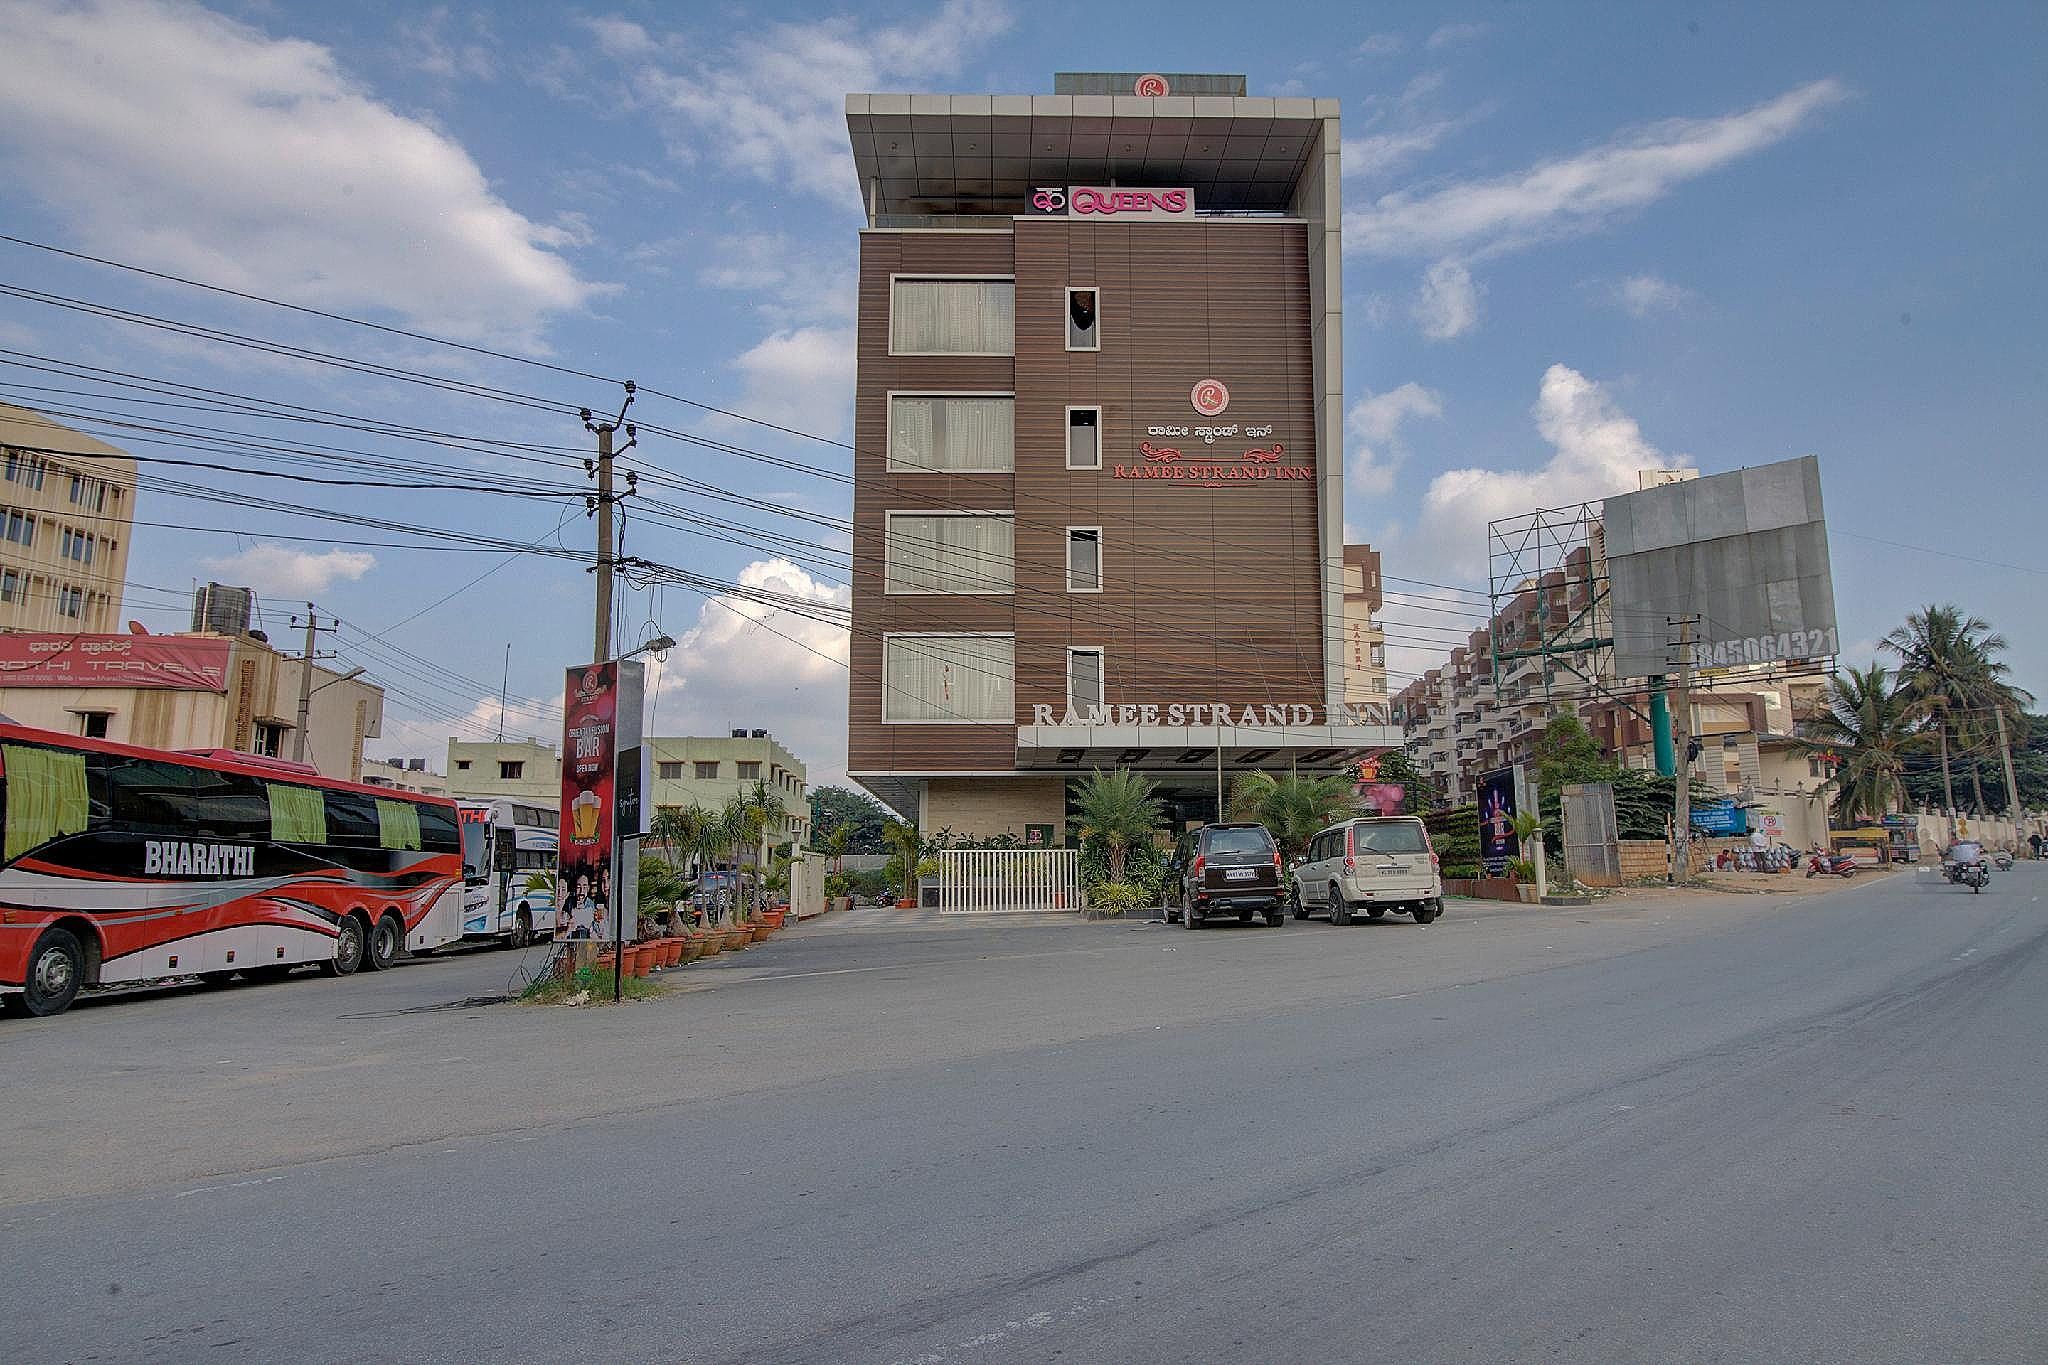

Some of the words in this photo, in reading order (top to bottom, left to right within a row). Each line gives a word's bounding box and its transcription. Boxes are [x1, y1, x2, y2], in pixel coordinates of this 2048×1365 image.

[1072, 188, 1187, 214] QUEENS
[1112, 464, 1184, 479] RAMEE
[1188, 465, 1269, 479] STRAND
[1274, 465, 1312, 480] INN
[86, 660, 221, 677] TRAVELS
[1033, 703, 1161, 726] RAMEE
[1167, 703, 1314, 726] STRAND
[1325, 703, 1391, 726] INN
[576, 736, 600, 759] BAR
[145, 840, 255, 875] BHARATHI
